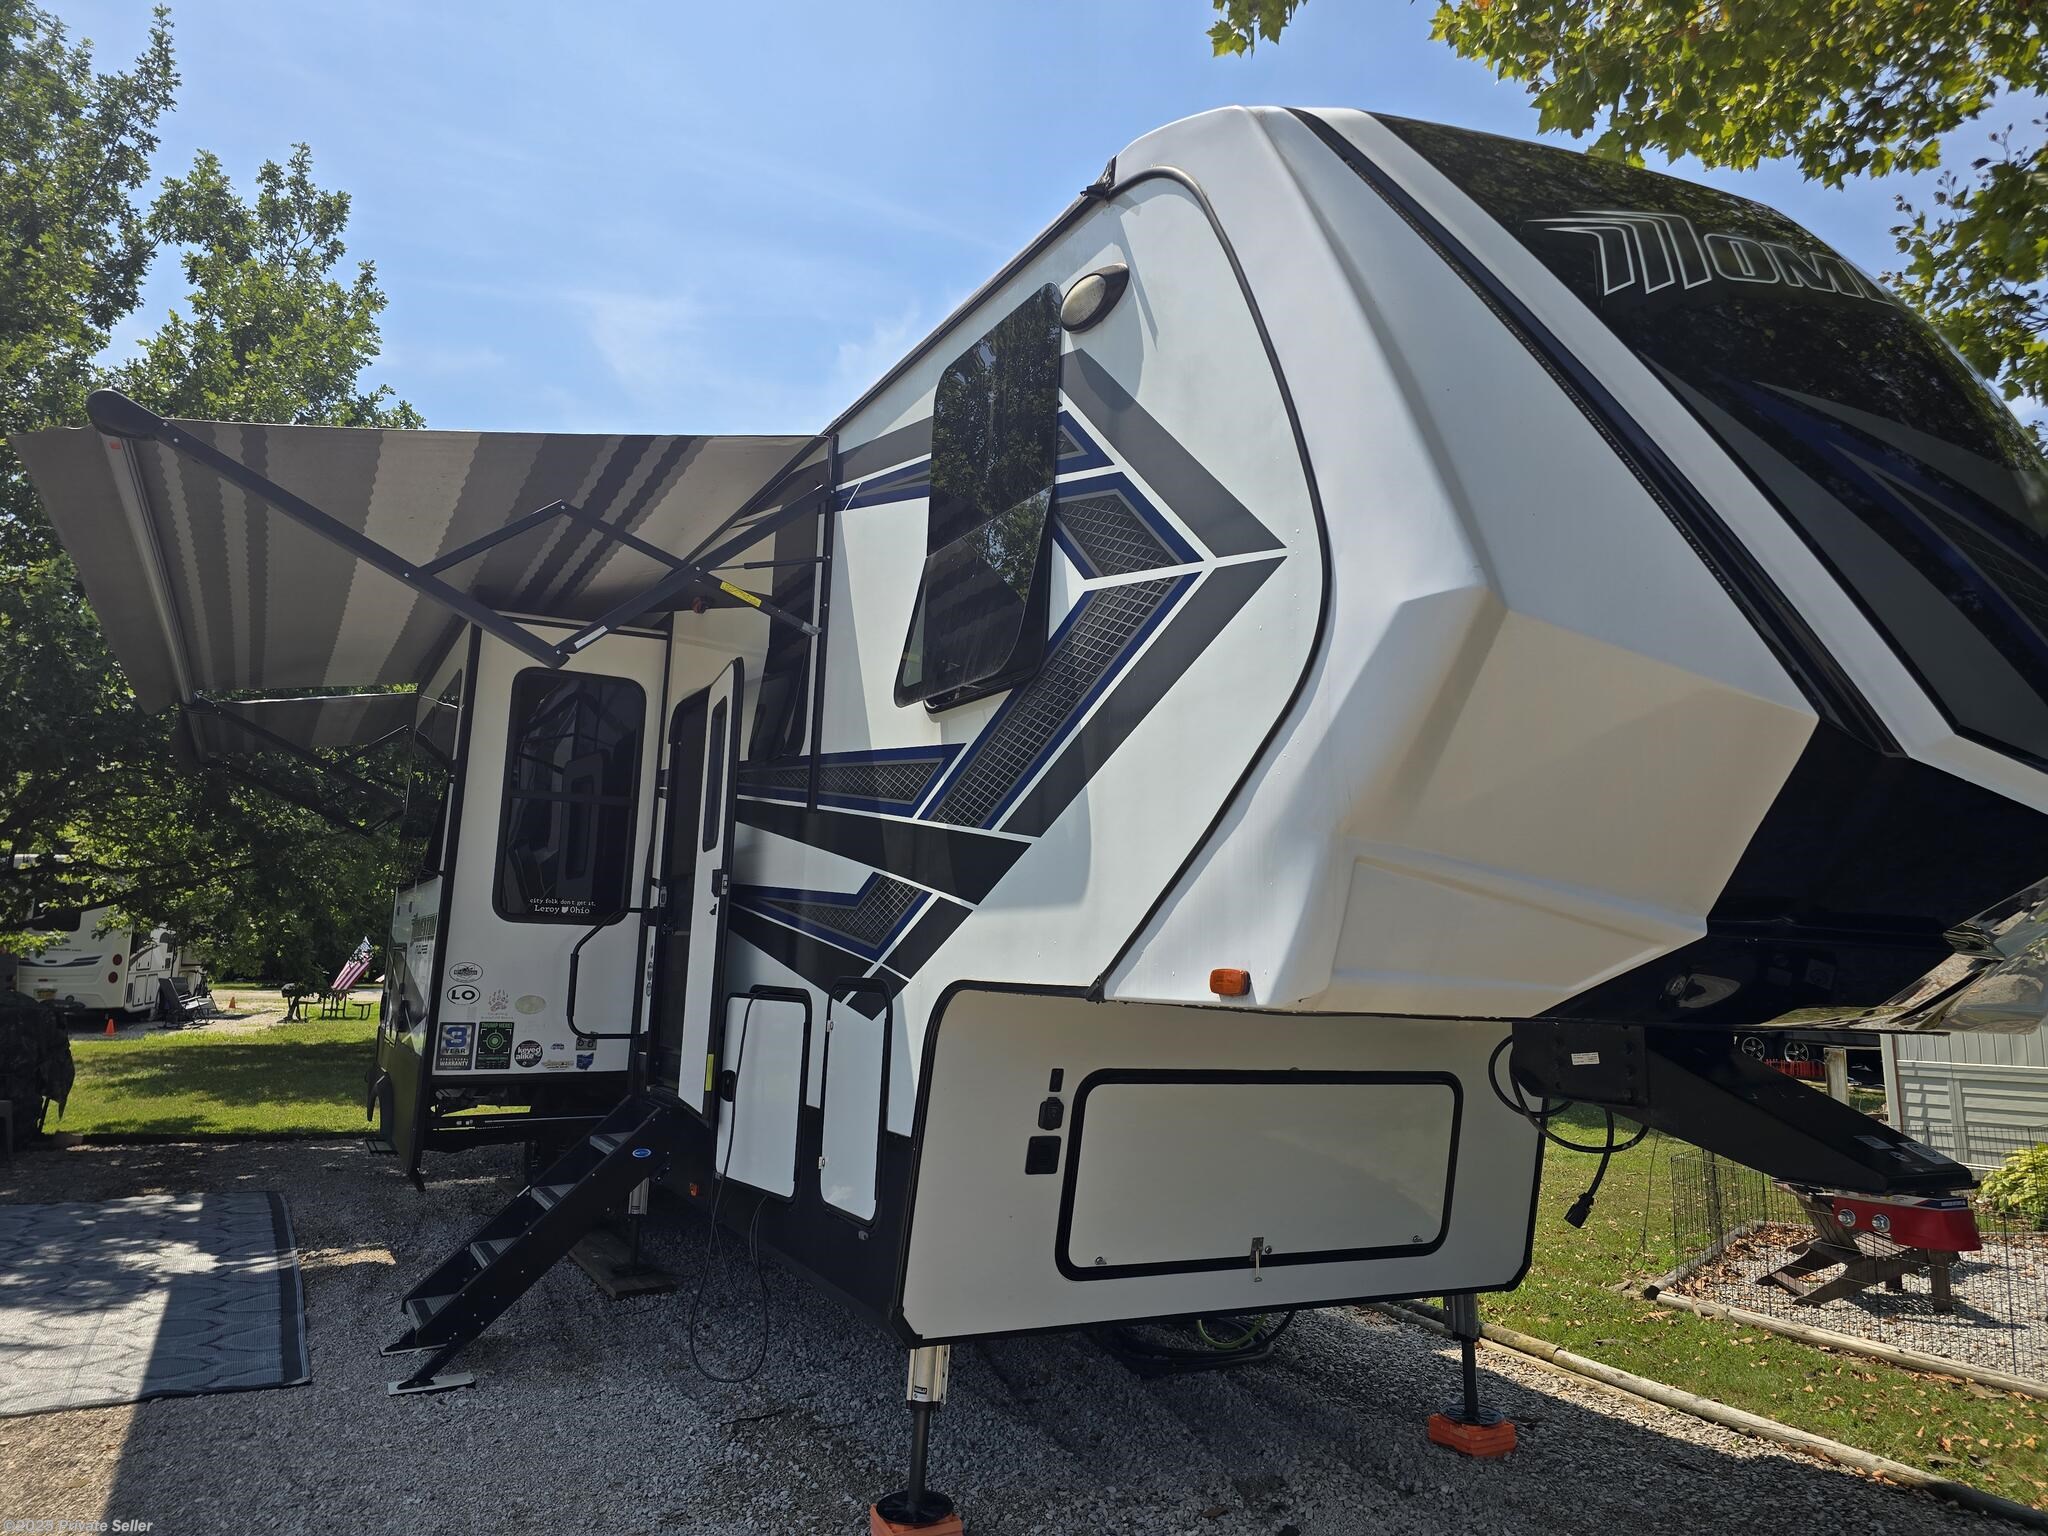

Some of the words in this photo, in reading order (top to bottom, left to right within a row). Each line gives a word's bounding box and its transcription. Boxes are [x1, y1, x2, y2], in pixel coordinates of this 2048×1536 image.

[534, 904, 560, 914] Leroy
[569, 906, 590, 914] Ohio
[451, 989, 476, 1001] LO
[445, 1026, 468, 1048] 3
[517, 1046, 542, 1056] keyed
